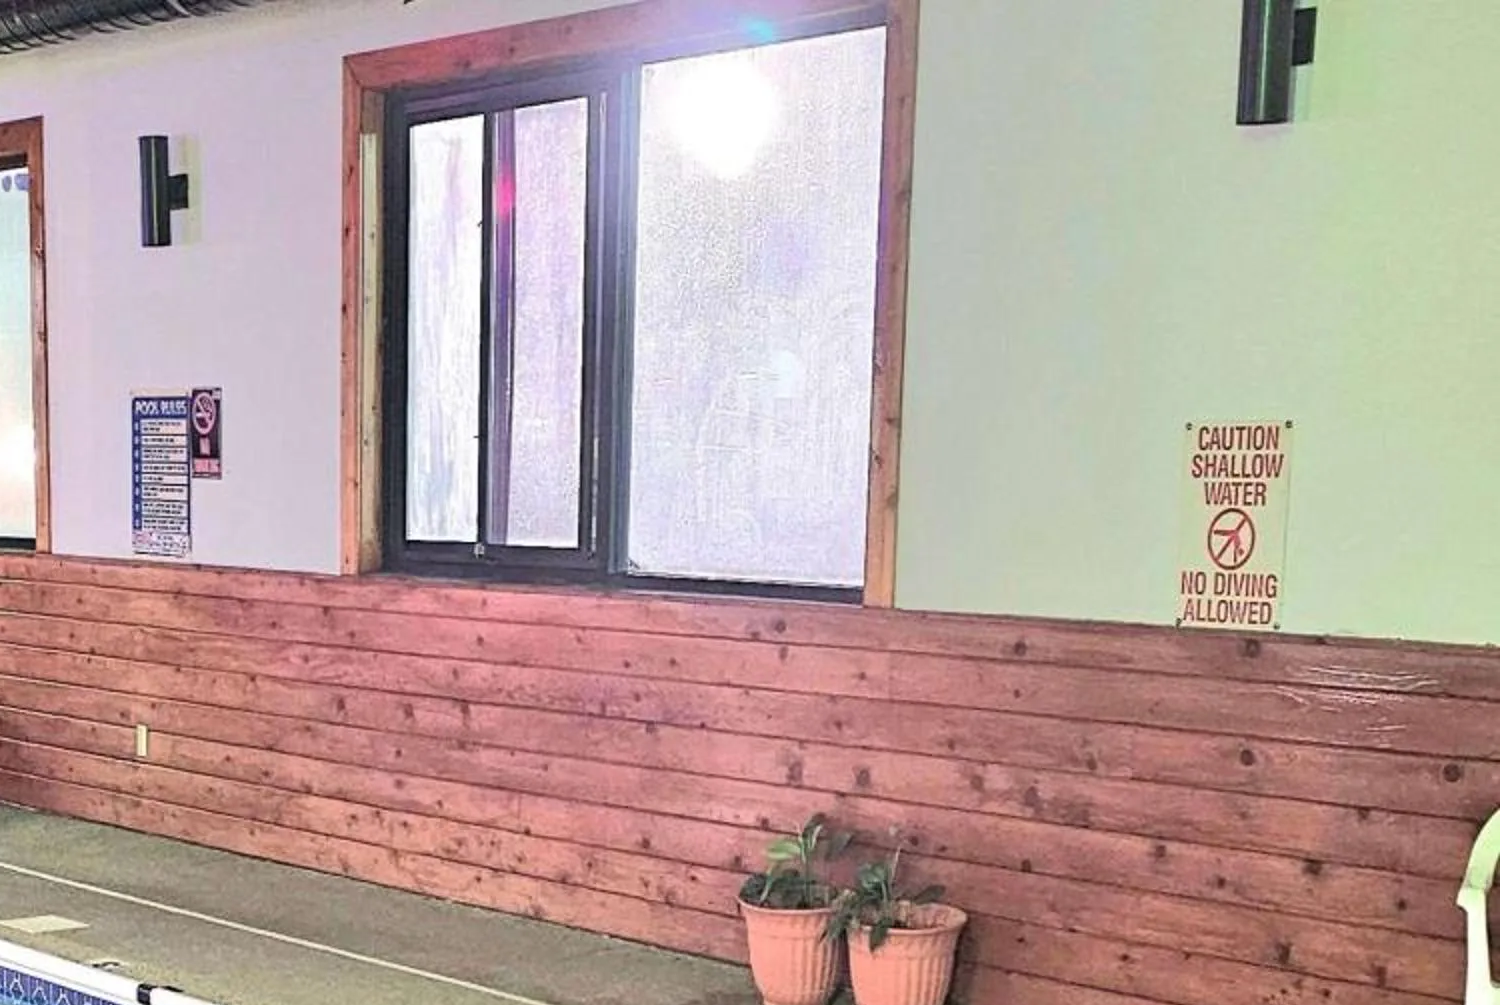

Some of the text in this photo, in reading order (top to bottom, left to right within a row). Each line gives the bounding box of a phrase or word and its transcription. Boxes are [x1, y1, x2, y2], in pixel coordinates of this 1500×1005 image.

[135, 400, 159, 416] POOL
[1199, 426, 1280, 450] CAUTION
[1191, 454, 1284, 478] SHALLOW
[1204, 482, 1267, 506] WATER
[1180, 571, 1278, 599] NO DIVING
[1182, 599, 1273, 625] ALLOWED
